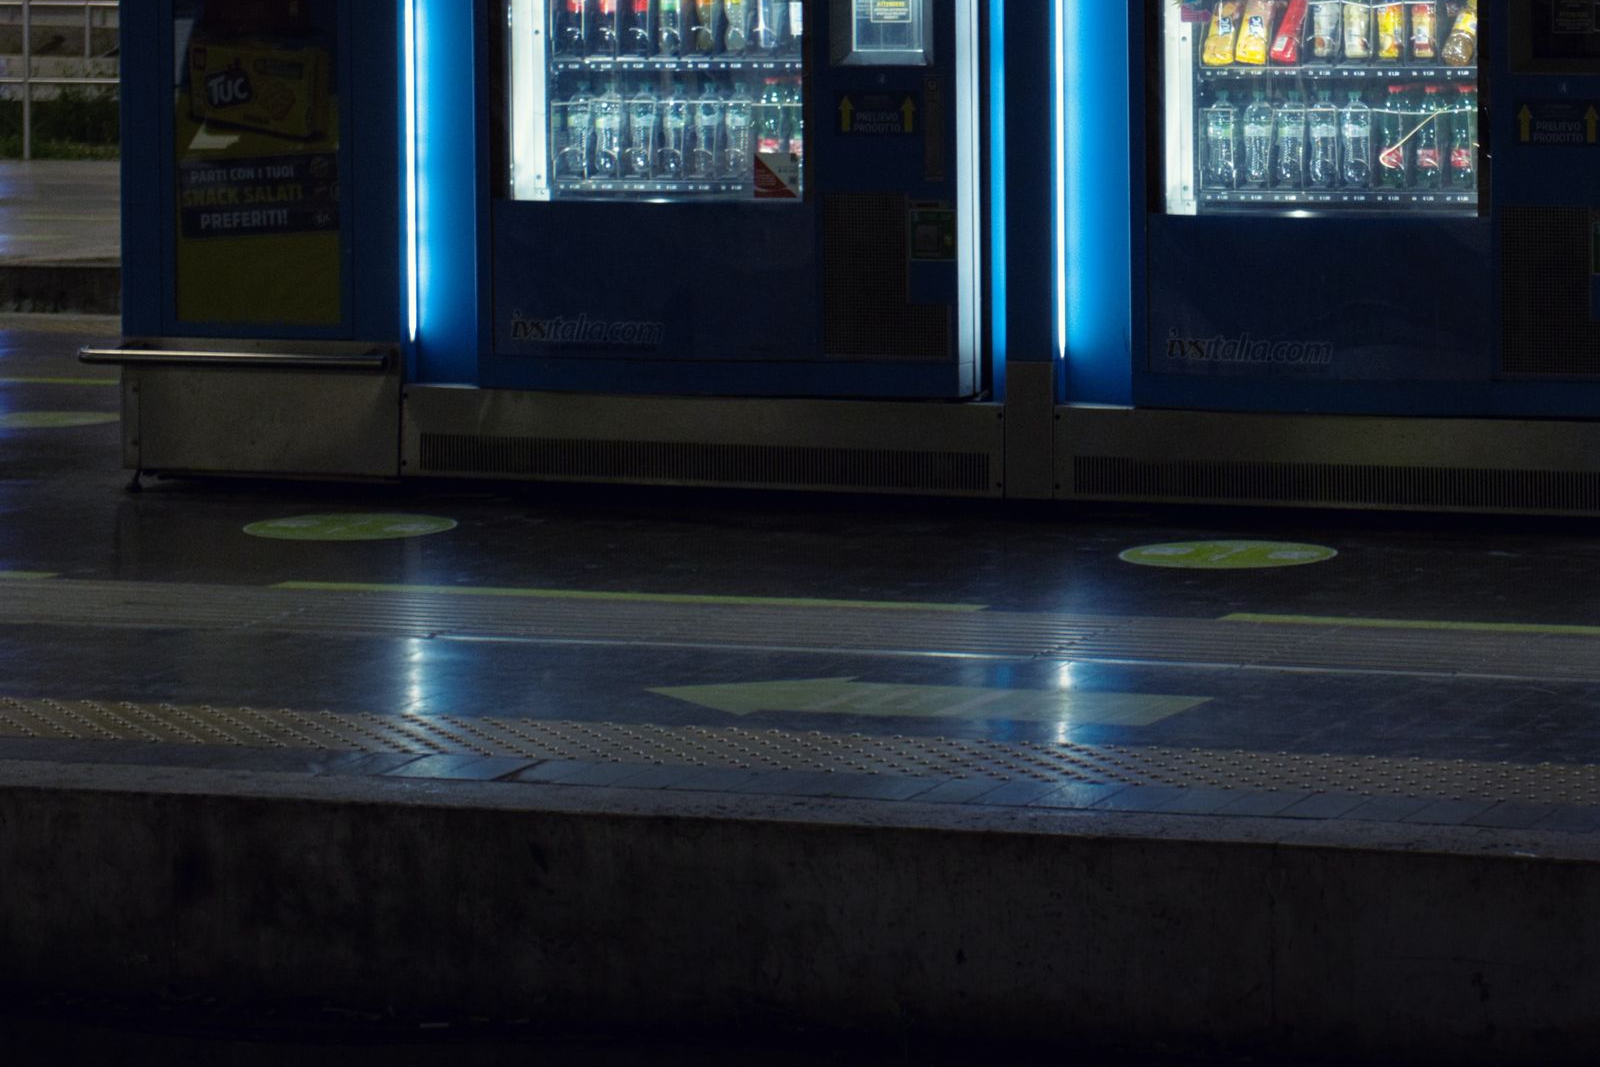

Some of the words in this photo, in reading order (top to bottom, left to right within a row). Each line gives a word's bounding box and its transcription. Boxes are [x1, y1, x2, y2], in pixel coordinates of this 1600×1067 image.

[206, 72, 250, 105] TUC
[1535, 121, 1582, 131] PRELIEVO
[1533, 132, 1584, 143] PRODOTTO
[190, 170, 227, 185] PARTI
[229, 167, 256, 181] CON
[265, 165, 294, 179] TUOI
[182, 188, 240, 207] SNACK
[242, 183, 304, 205] SALATI
[199, 208, 288, 230] PREFERITI!
